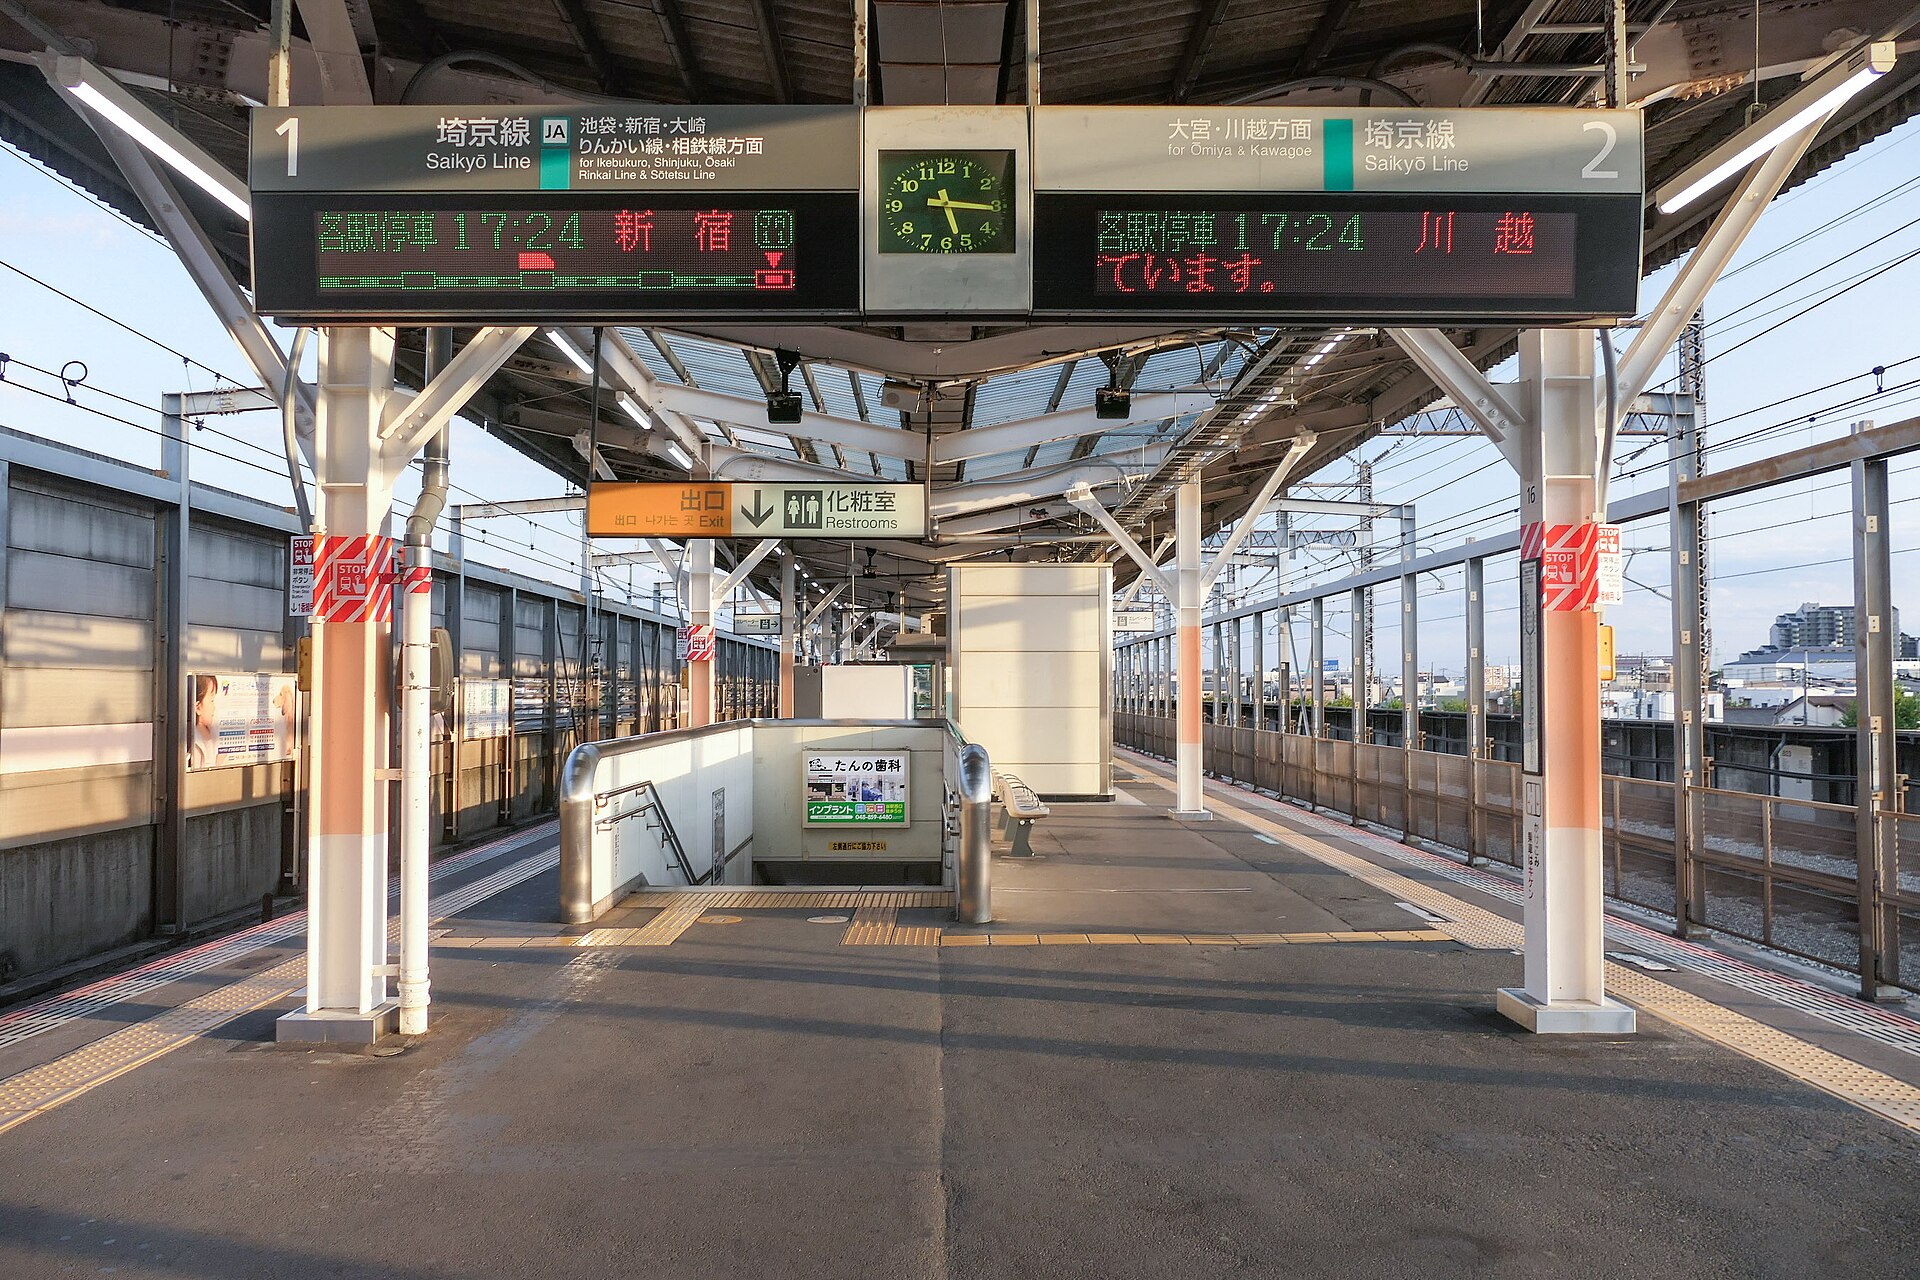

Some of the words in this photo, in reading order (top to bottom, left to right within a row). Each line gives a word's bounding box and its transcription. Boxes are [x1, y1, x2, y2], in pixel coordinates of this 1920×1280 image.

[436, 116, 531, 147] 埼京線
[545, 124, 566, 139] JA
[580, 116, 706, 135] 池袋・新宿・大崎
[1168, 118, 1312, 141] 大宮・川越方面
[1364, 118, 1456, 150] 埼京線
[275, 117, 299, 176] 1
[579, 137, 764, 155] りんかい線・相鉄線方面
[1168, 143, 1185, 156] for
[1190, 141, 1233, 159] Ōmiya
[1237, 146, 1245, 156] &
[1250, 144, 1312, 159] Kawagoe
[1582, 121, 1618, 179] 2
[426, 153, 487, 173] Saikyō
[493, 153, 531, 169] Line
[579, 157, 594, 168] for
[597, 157, 651, 169] Ikebukuro,
[654, 157, 702, 169] Shinjuku,
[705, 156, 736, 168] Ōsaki
[937, 162, 956, 174] 12
[1365, 154, 1426, 175] Saikyō
[1433, 155, 1469, 171] Line
[579, 170, 612, 180] Rinkai
[615, 170, 637, 180] Line
[640, 170, 648, 180] &
[693, 170, 716, 180] Line
[920, 168, 935, 180] 11
[963, 166, 970, 178] 1
[901, 180, 919, 193] 10
[980, 178, 992, 190] 2
[891, 200, 903, 212] 9
[991, 200, 1001, 212] 3
[759, 214, 786, 228] JA
[901, 221, 914, 234] 8
[318, 211, 438, 252] 各駅停車
[453, 212, 585, 249] 17:24
[980, 222, 991, 234] 4
[1097, 210, 1218, 252] 各駅停車
[1233, 213, 1364, 250] 17:24
[921, 234, 932, 246] 7
[941, 237, 952, 250] 6
[960, 234, 972, 247] 5
[681, 488, 725, 511] 出口
[826, 490, 896, 512] 化粧室
[1527, 485, 1536, 504] 16
[614, 515, 637, 526] 出口
[646, 514, 678, 526] 나가는
[700, 515, 724, 527] Exit
[826, 516, 898, 529] Restrooms
[1599, 528, 1619, 536] STOP
[294, 540, 313, 548] STOP
[1546, 553, 1574, 562] STOP
[339, 564, 366, 574] STOP
[835, 759, 902, 772] たんの歯科
[809, 804, 853, 814] インプラント
